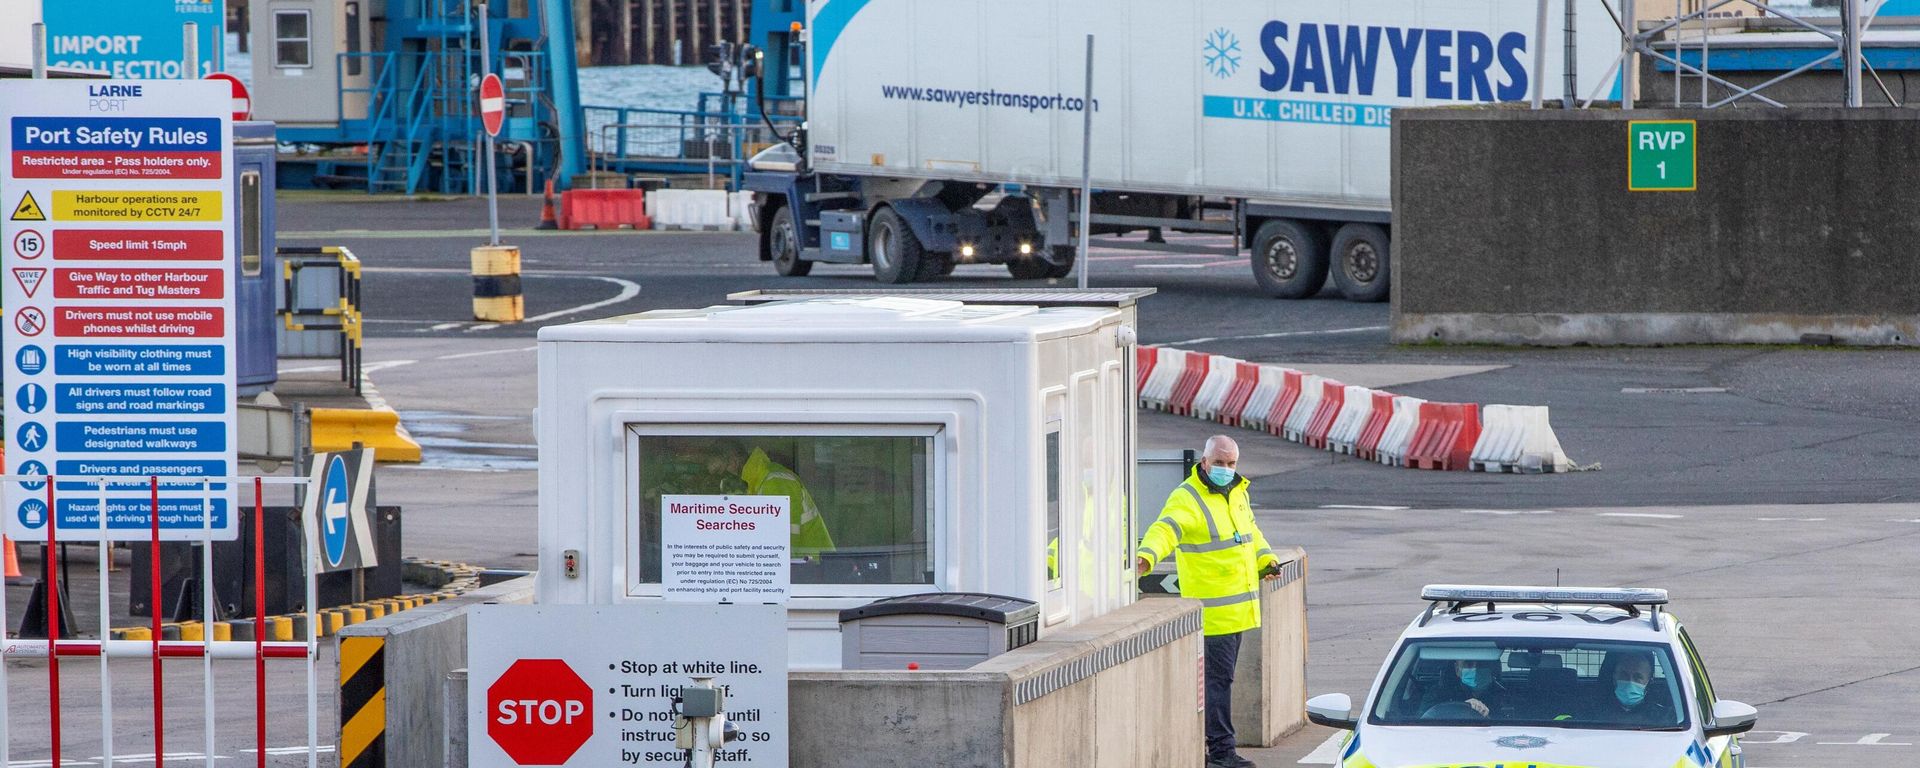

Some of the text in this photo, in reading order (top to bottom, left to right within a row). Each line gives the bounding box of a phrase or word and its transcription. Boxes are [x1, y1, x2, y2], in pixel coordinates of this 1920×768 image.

[54, 36, 141, 54] IMPORT
[1260, 20, 1528, 102] SAWYERS
[89, 86, 142, 97] LARNE
[89, 99, 128, 112] PORT
[1233, 99, 1271, 118] U.K.
[1279, 102, 1356, 123] CHILLED
[26, 127, 207, 148] Port Safety Rules
[1639, 131, 1686, 150] RVP
[23, 156, 78, 165] Restricted
[115, 157, 141, 165] Pass
[144, 157, 184, 166] holders
[186, 157, 211, 167] only.
[1656, 161, 1666, 179] 1
[77, 195, 119, 203] Harbour
[122, 195, 178, 205] operations
[74, 208, 200, 218] monitored by CCTV 24/7
[20, 238, 37, 251] 15
[90, 240, 187, 251] Speed limit 15mph
[69, 272, 208, 283] Give Way to other Harbour
[77, 285, 200, 296] Traffic and Tug Masters
[66, 311, 103, 319] Drivers
[177, 311, 212, 320] mobile
[84, 324, 194, 335] phones whilst driving
[68, 349, 211, 360] High visibility clothing must
[89, 362, 101, 371] be
[134, 363, 144, 371] at
[147, 362, 159, 371] all
[162, 362, 191, 371] times
[69, 388, 82, 396] All
[85, 388, 121, 396] drivers
[153, 388, 184, 396] follow
[188, 388, 211, 396] road
[76, 401, 204, 411] signs and road markings
[85, 426, 146, 434] Pedestrians
[85, 439, 197, 449] designated walkways
[80, 464, 203, 475] Drivers and passengers
[671, 503, 781, 517] Maritime Security
[65, 514, 87, 522] used
[115, 514, 145, 524] driving
[184, 514, 218, 522] harbur
[697, 519, 755, 530] Searches
[621, 661, 762, 676] Stop at white line.
[621, 685, 656, 697] Turn
[497, 700, 584, 724] STOP
[622, 709, 760, 721] Do not until
[622, 729, 770, 741] instruc so
[622, 749, 752, 764] by staff.
